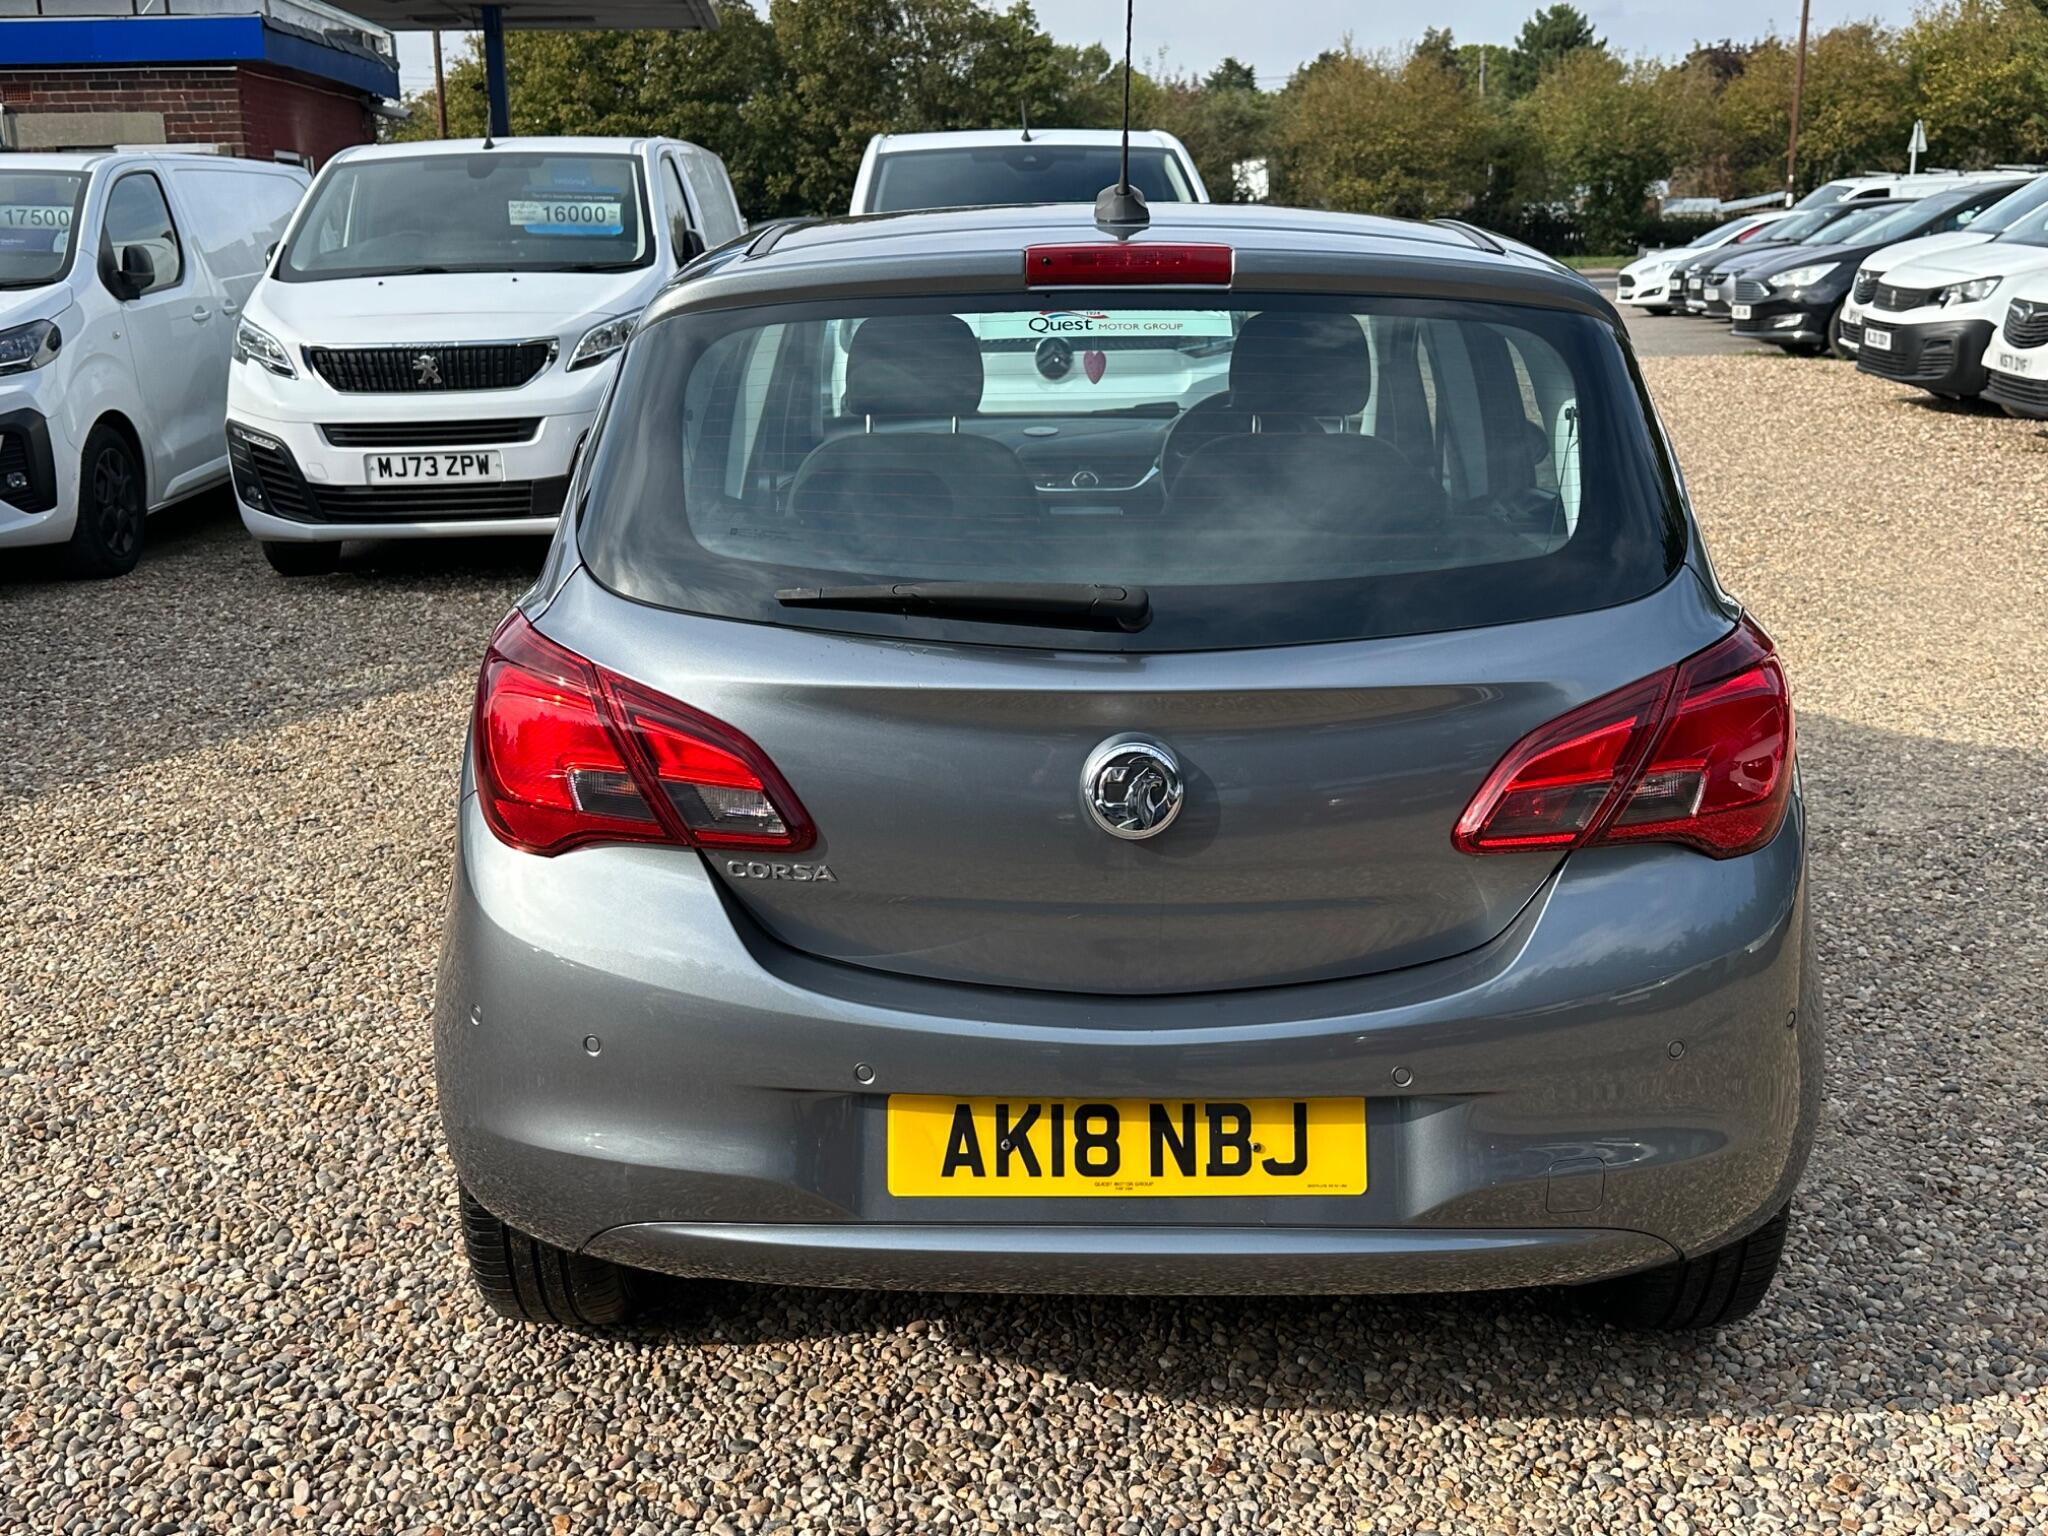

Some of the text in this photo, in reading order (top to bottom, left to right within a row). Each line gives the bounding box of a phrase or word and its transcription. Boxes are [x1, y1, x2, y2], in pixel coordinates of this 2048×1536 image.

[4, 209, 70, 226] 17500
[543, 205, 606, 223] 16000
[1028, 317, 1184, 333] Quest MOTOR GROUP
[377, 454, 490, 478] MJ73 ZPW
[726, 860, 838, 882] CORSA
[941, 1102, 1308, 1177] AK18 NBJ
